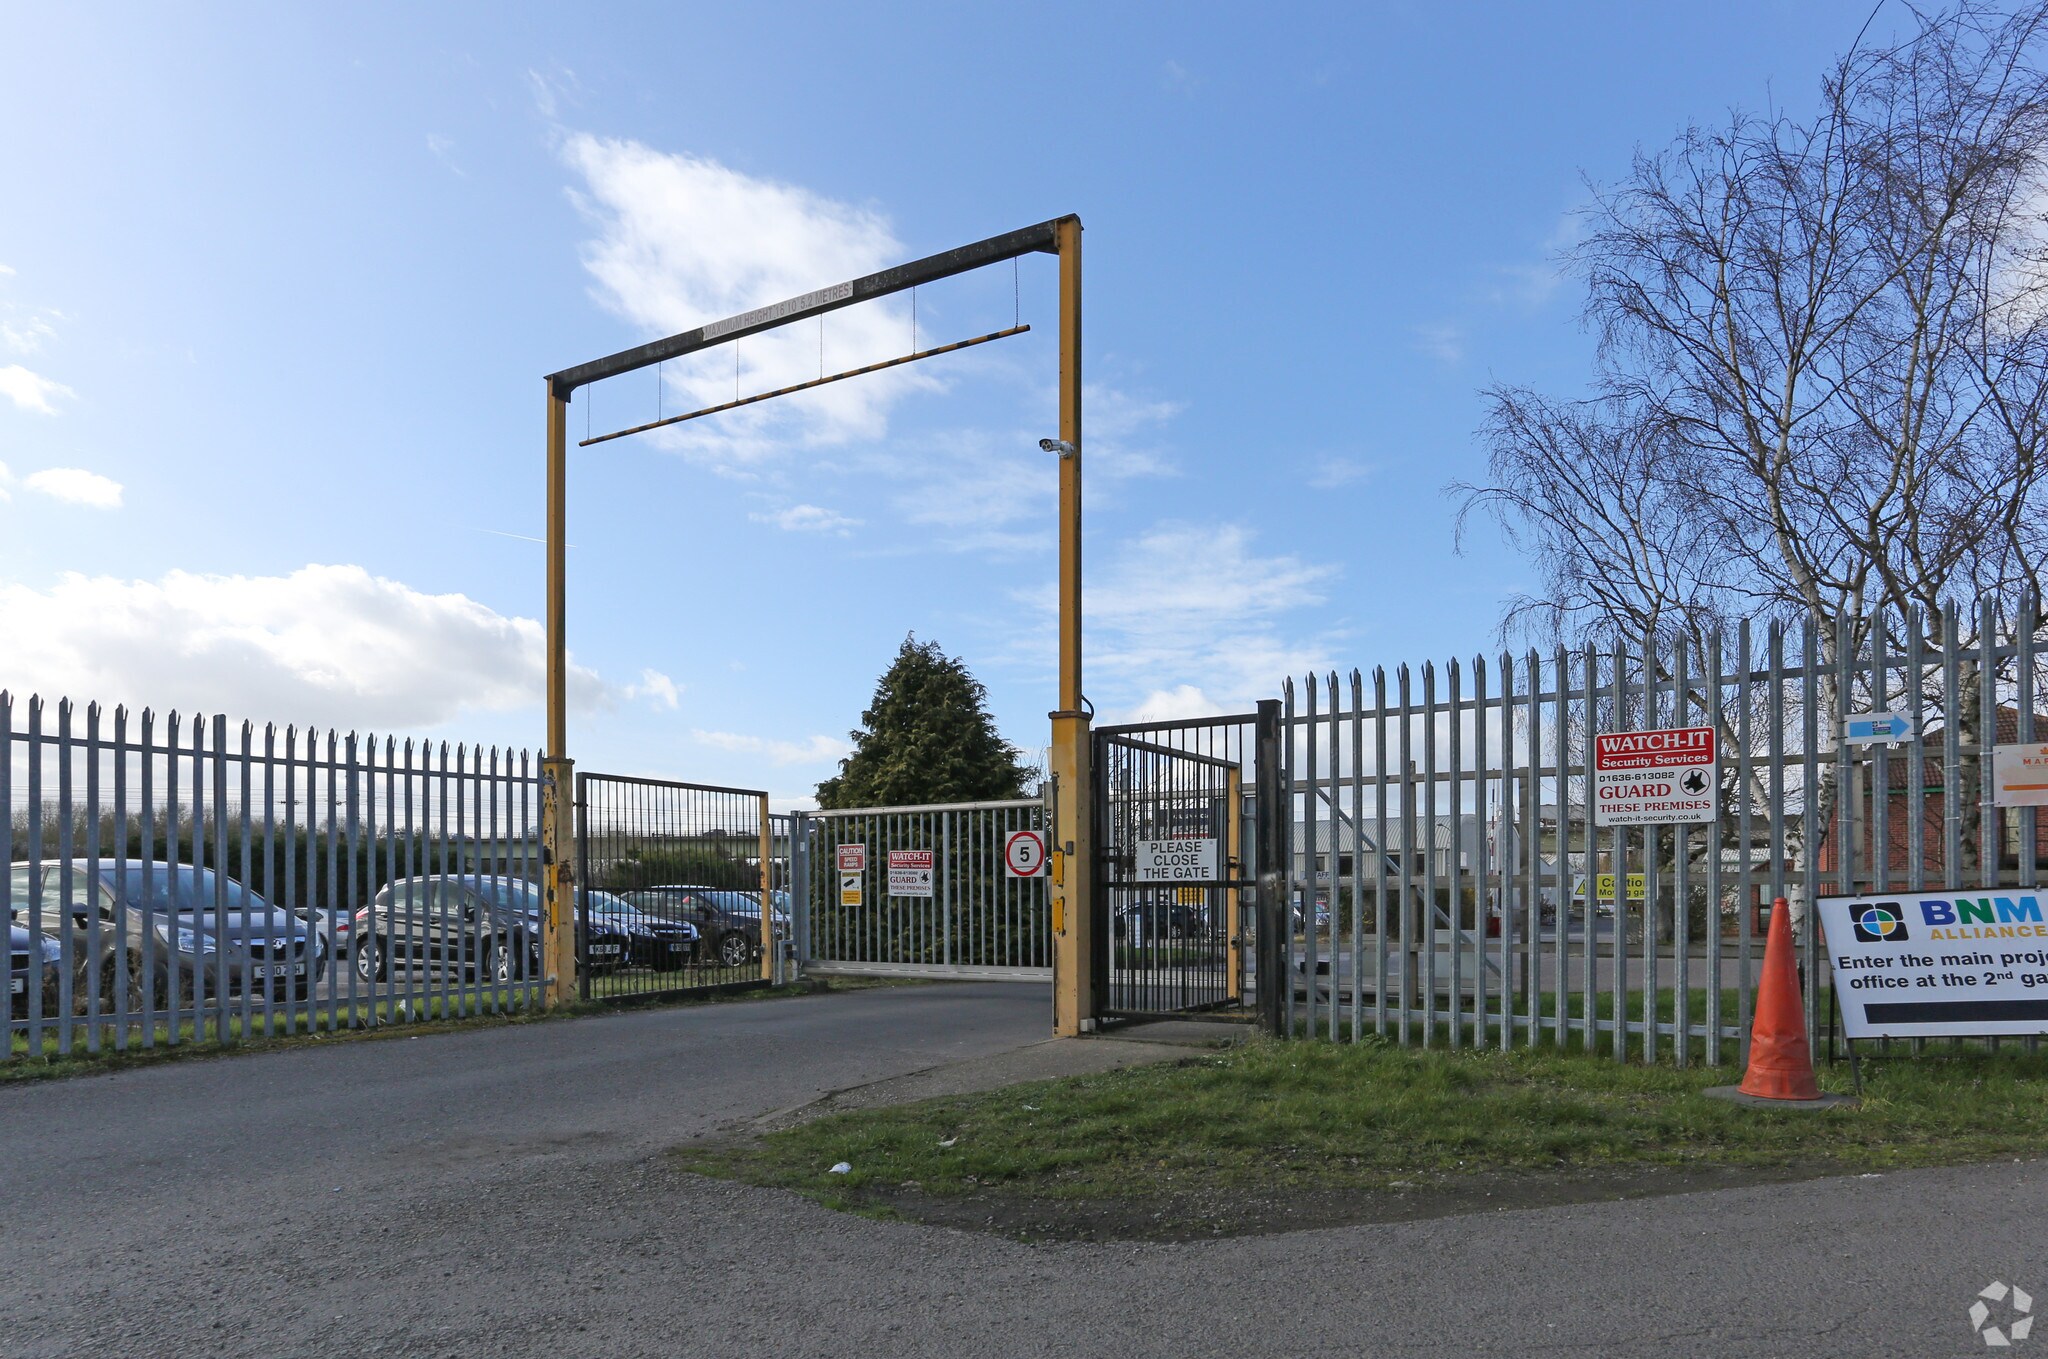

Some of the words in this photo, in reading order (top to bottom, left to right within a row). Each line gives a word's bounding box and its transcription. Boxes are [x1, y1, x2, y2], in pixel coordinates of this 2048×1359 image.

[744, 308, 773, 326] HEIGHT
[815, 283, 849, 304] METRES
[1601, 731, 1709, 752] WATCH-IT
[1602, 757, 1651, 768] Security
[1655, 754, 1708, 765] Services
[1599, 783, 1671, 799] GUARD
[1600, 803, 1640, 813] THESE
[1644, 800, 1711, 812] PREMISES
[1609, 813, 1701, 823] watch-it-security.co.uk
[1019, 846, 1030, 862] 5
[1150, 841, 1202, 853] PLEASE
[891, 852, 930, 860] WATCH-IT
[1153, 854, 1199, 866] CLOSE
[1143, 867, 1169, 878] THE
[1173, 866, 1209, 878] GATE
[1602, 878, 1645, 887] Ctio
[1919, 896, 2044, 926] BNM
[1930, 925, 2048, 940] ALLIANCE
[1838, 955, 1894, 969] Enter
[1900, 954, 1934, 968] the
[1941, 951, 1994, 966] main
[2000, 950, 2048, 967] proj
[1850, 975, 1909, 989] office
[1916, 974, 1936, 987] at
[1941, 973, 1977, 986] the
[1983, 971, 2014, 986] 2nd
[2020, 973, 2048, 988] ga
